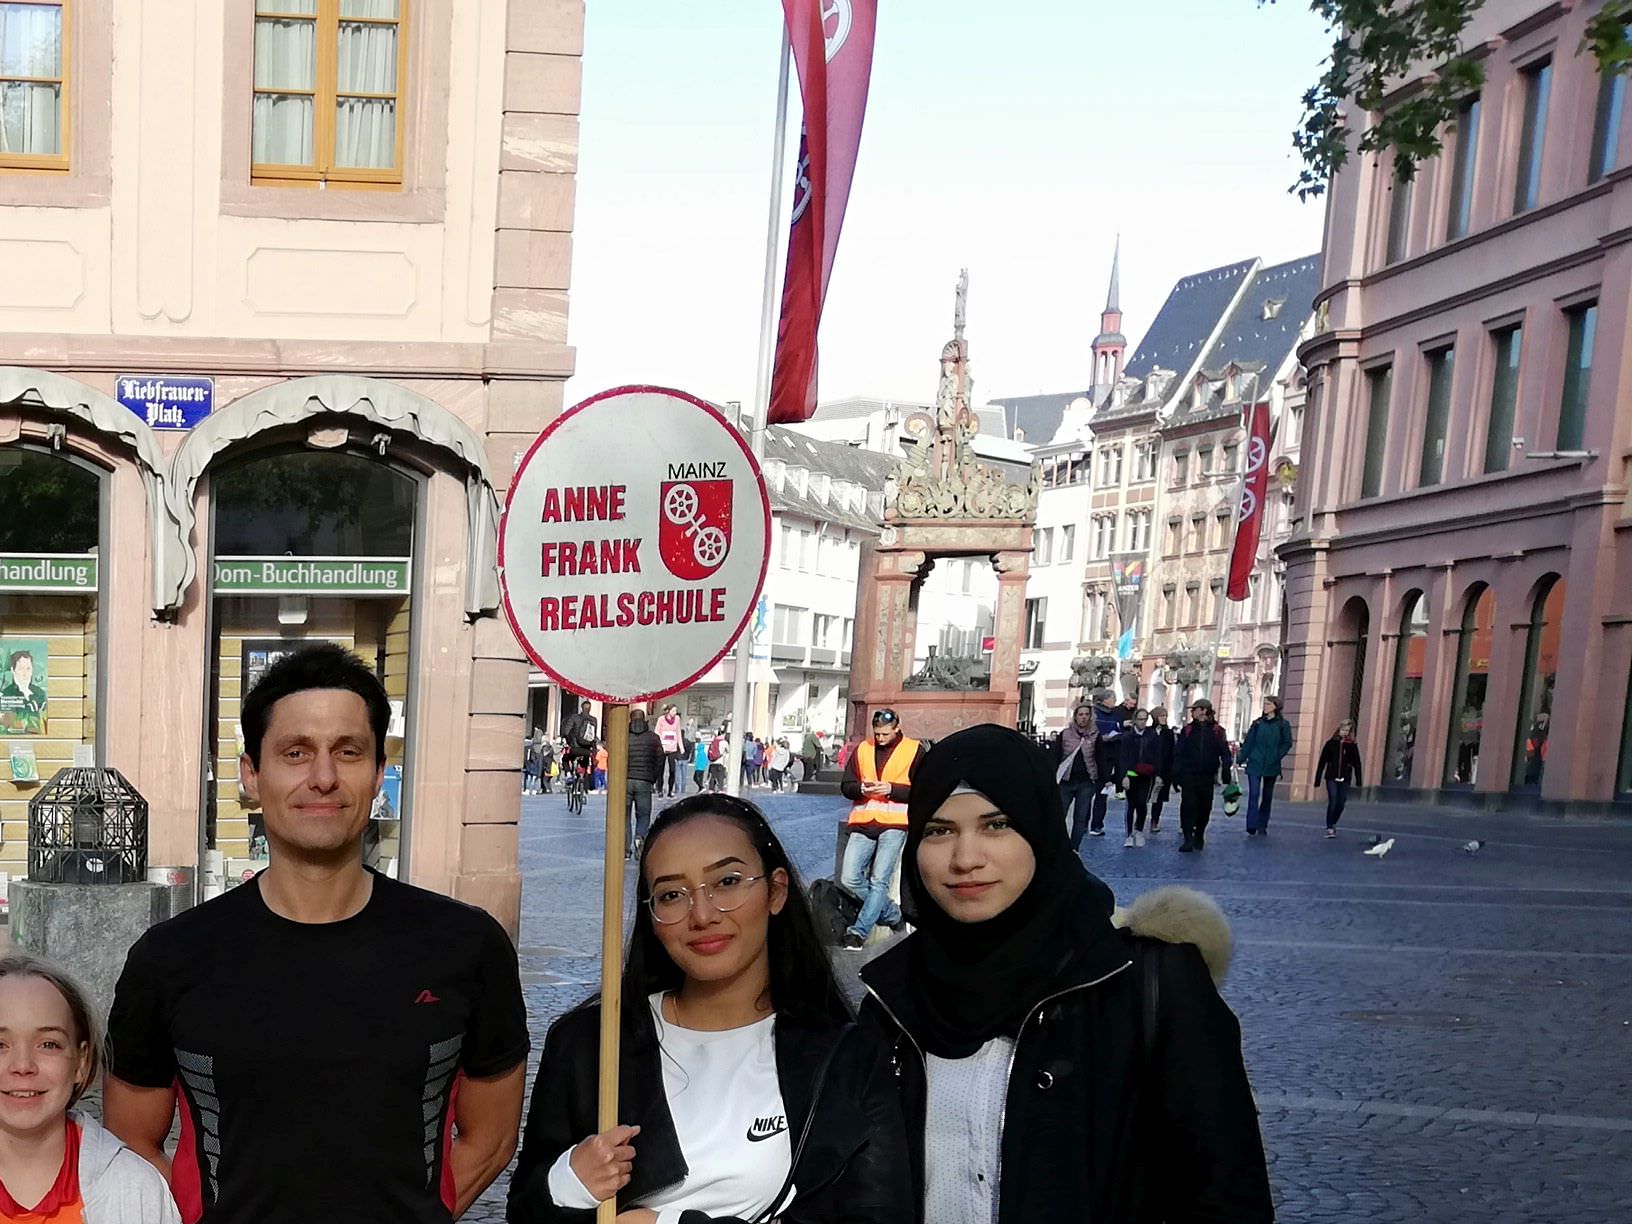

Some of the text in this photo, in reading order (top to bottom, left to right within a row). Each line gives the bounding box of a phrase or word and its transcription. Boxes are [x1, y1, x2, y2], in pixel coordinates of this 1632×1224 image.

[121, 379, 209, 402] Liebfrauen-
[668, 461, 727, 479] MAINZ
[541, 484, 627, 523] ANNE
[541, 538, 643, 577] FRANK
[540, 587, 727, 631] REALSCHULE
[753, 1115, 785, 1132] NIKE
